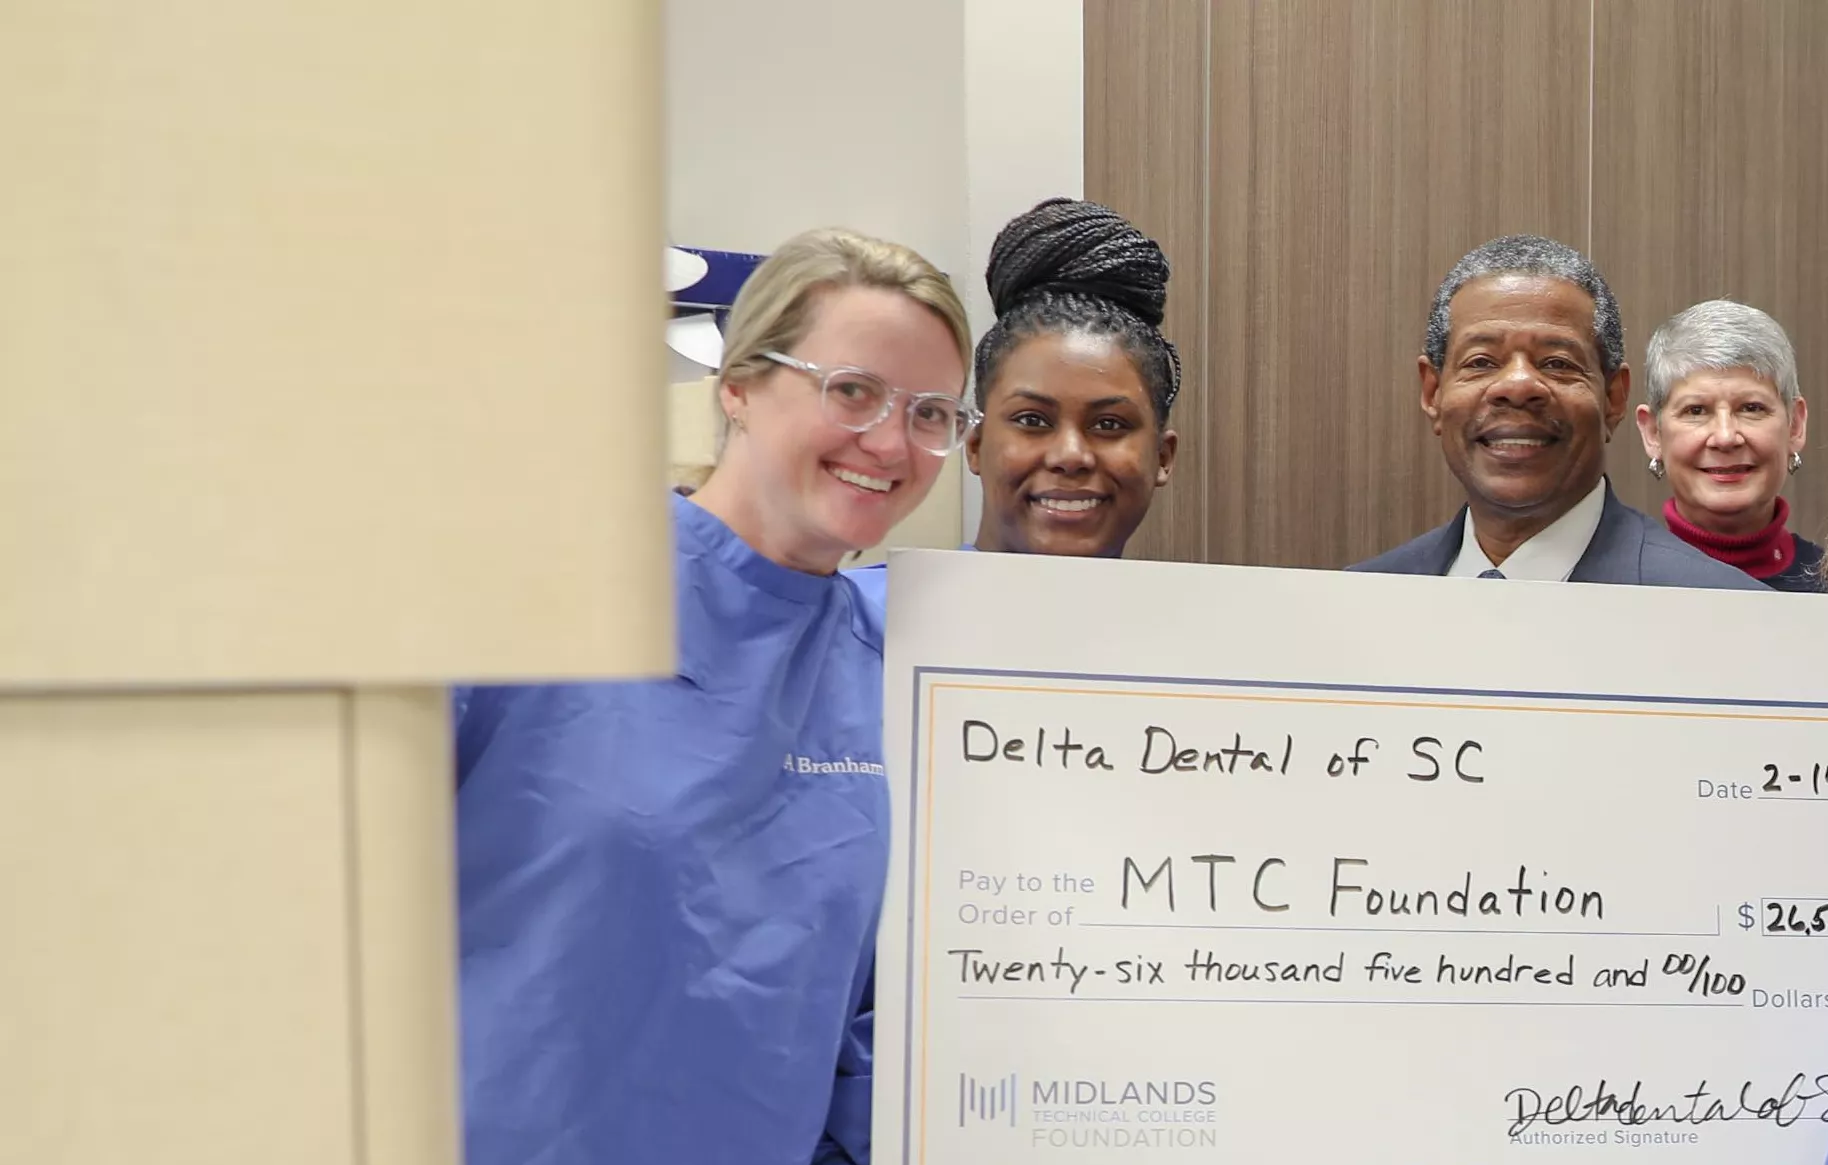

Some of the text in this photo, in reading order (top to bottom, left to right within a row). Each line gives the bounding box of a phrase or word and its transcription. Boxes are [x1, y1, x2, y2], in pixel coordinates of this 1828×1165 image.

[962, 719, 1485, 784] Delta Dental of SC
[797, 756, 885, 776] Branham
[1698, 779, 1753, 800] Date
[958, 869, 1095, 896] Pay to the
[1121, 853, 1603, 920] MTC Foundation
[958, 903, 1075, 926] Order of
[1737, 901, 1756, 931] $
[947, 946, 1165, 994] Twenty-six
[1184, 948, 1345, 983] thousand
[1364, 951, 1423, 984] five
[1436, 953, 1574, 986] hundred
[1592, 958, 1649, 988] and
[1032, 1080, 1217, 1106] MIDLANDS
[1032, 1110, 1217, 1124] TECHNICAL COLLEGE
[1031, 1128, 1217, 1149] FOUNDATION
[1508, 1128, 1699, 1149] Authorized Signature
